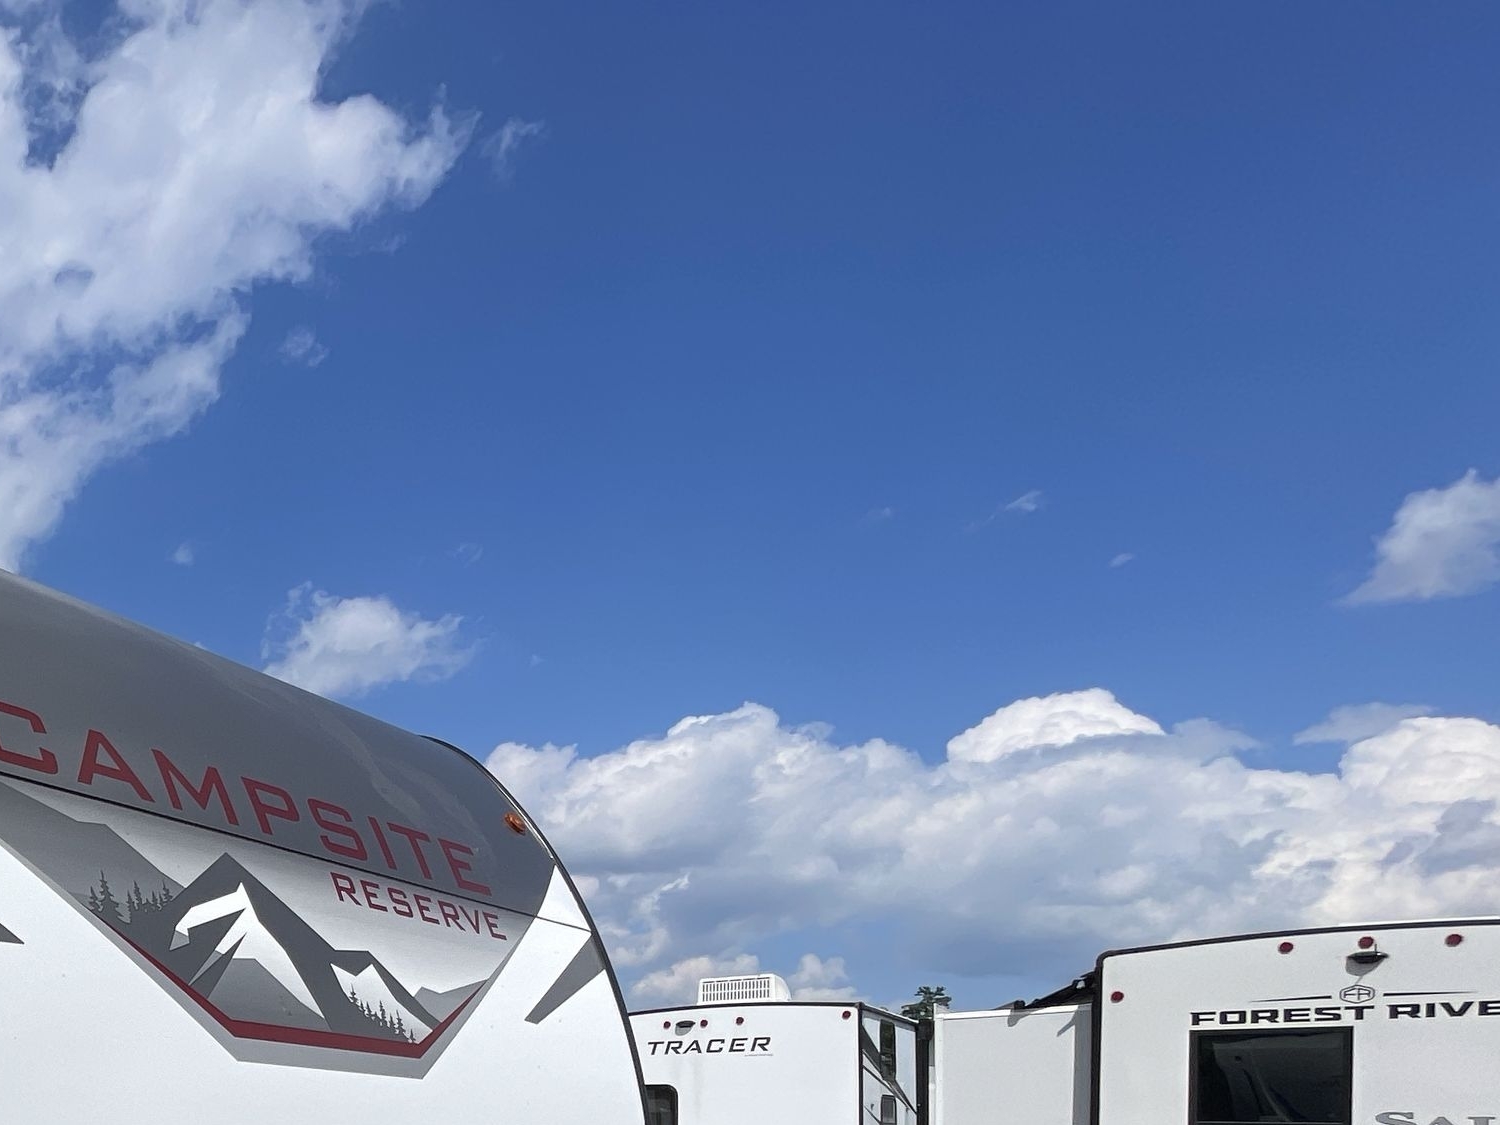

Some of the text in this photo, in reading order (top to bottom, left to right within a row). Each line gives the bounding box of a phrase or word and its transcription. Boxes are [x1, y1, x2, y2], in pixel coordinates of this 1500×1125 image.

[330, 871, 507, 940] RESERVE
[1190, 1005, 1375, 1026] FOREST
[647, 1036, 772, 1055] TRACER
